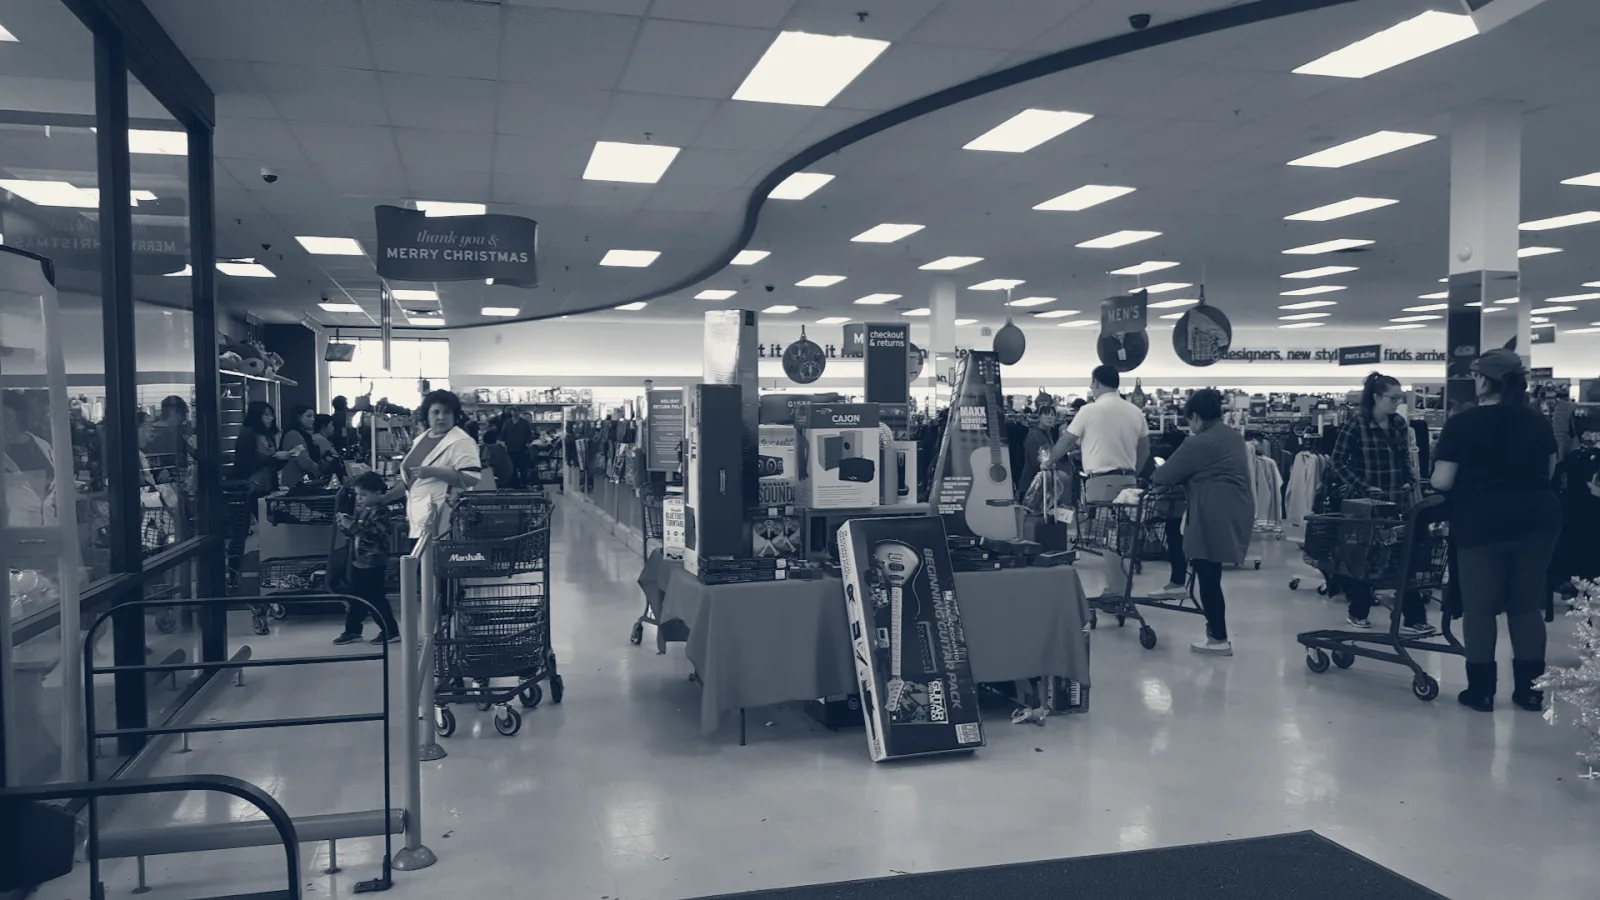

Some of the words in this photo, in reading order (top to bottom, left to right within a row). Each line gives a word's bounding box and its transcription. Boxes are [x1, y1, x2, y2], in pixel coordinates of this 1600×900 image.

[416, 229, 457, 244] thank
[459, 235, 485, 247] you
[487, 234, 500, 247] &
[386, 247, 439, 260] MERRY
[443, 249, 528, 263] CHRISTMAS
[1107, 304, 1140, 322] MEN'S
[869, 330, 905, 339] checkout
[869, 339, 876, 347] &
[876, 339, 905, 347] returns
[1287, 350, 1312, 360] new
[1314, 348, 1338, 363] styl
[1383, 348, 1413, 361] finds
[831, 414, 860, 423] CAJON
[960, 406, 986, 417] MAXX
[923, 547, 945, 619] BEGINNING
[937, 620, 954, 670] GUITAR
[947, 672, 963, 710] PACK
[932, 680, 945, 721] GUITAR
